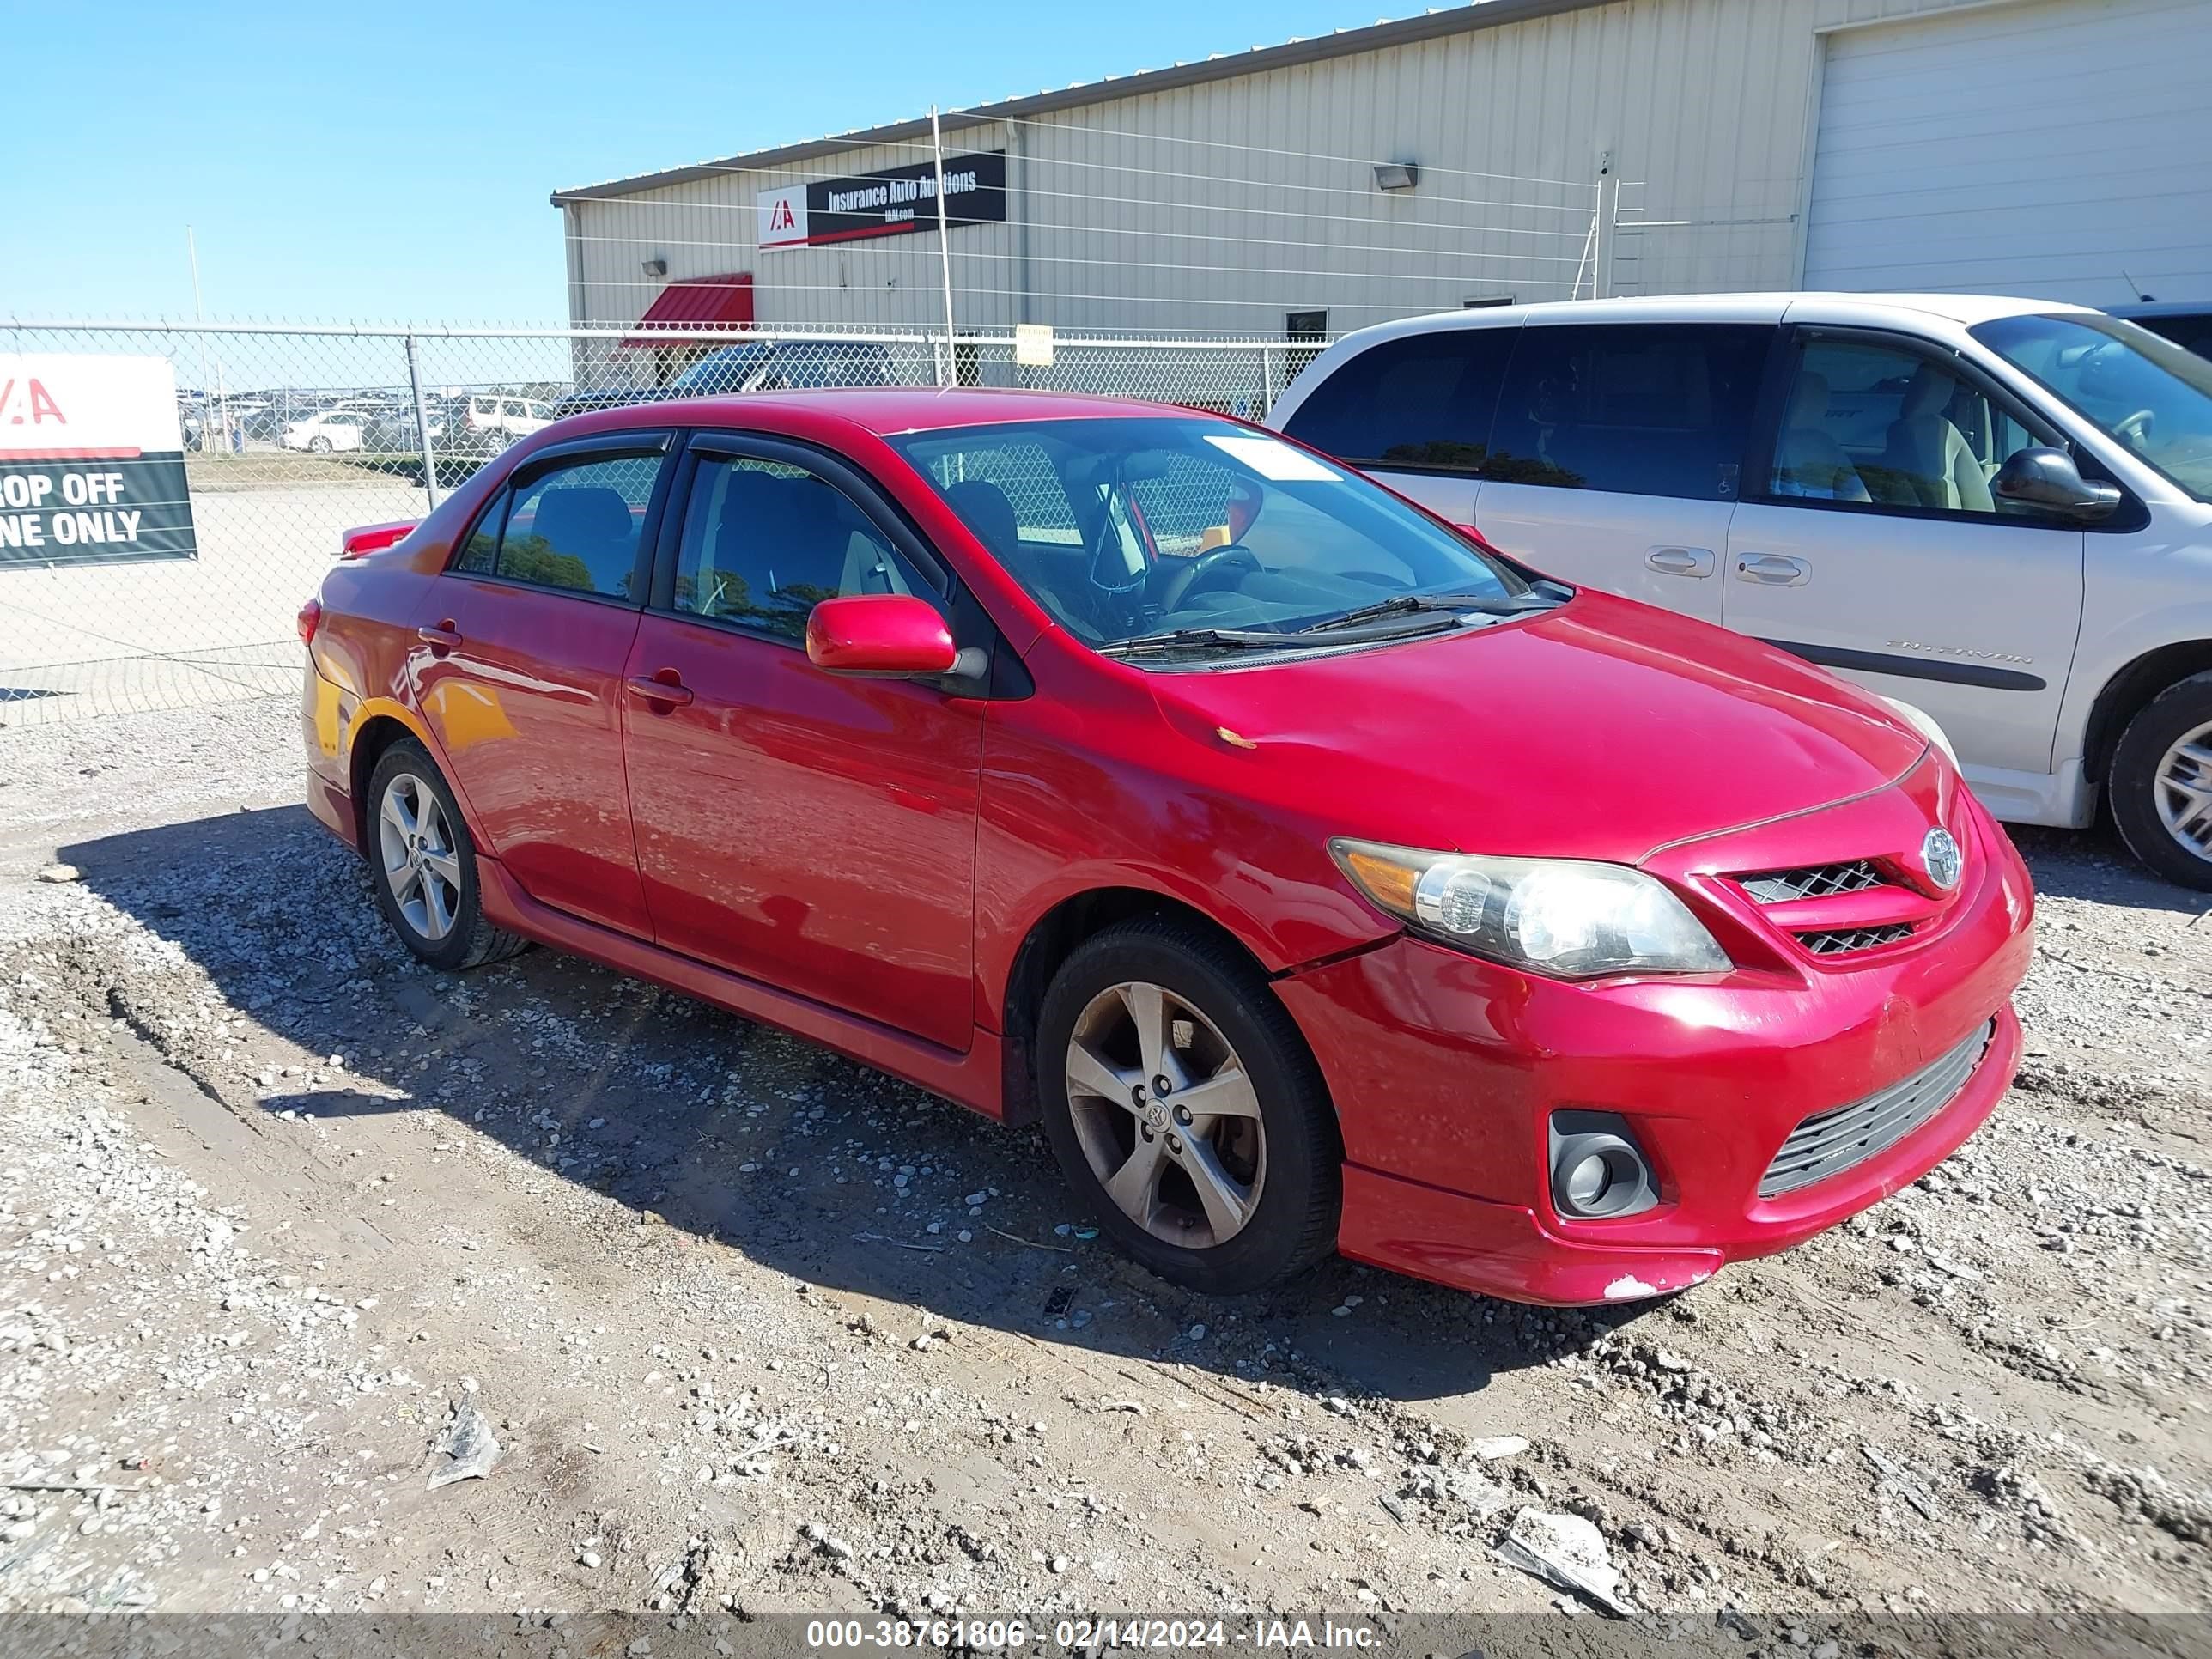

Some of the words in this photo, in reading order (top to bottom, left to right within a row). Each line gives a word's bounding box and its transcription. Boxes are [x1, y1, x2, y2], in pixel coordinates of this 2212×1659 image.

[829, 186, 887, 213] Insurance
[889, 180, 917, 204] Auto
[62, 472, 125, 506] OFF
[52, 510, 142, 545] ONLY
